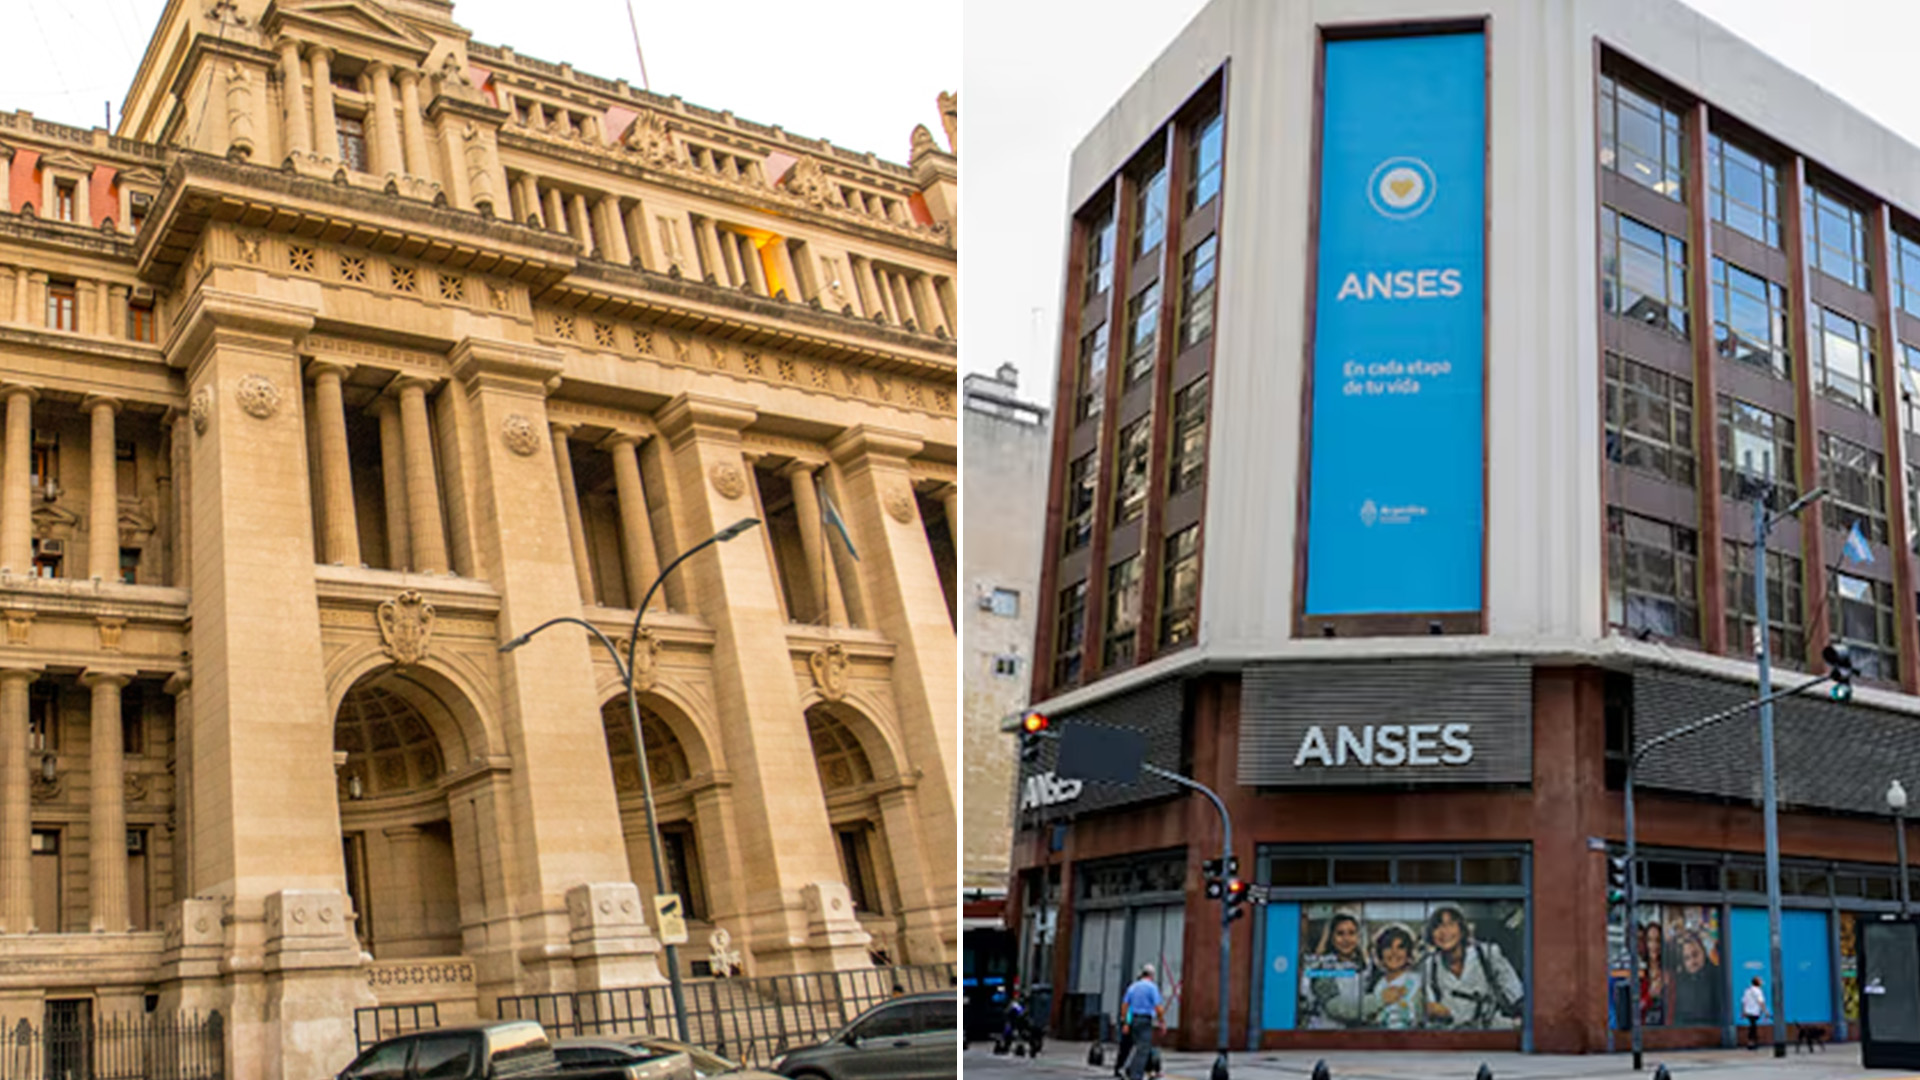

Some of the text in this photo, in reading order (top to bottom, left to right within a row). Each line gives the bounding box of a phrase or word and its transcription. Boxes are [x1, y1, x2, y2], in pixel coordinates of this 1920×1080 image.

[1337, 269, 1462, 300] ANSES
[1343, 359, 1451, 377] En cada etapa
[1343, 378, 1420, 395] de tu vida
[1294, 723, 1473, 766] ANSES
